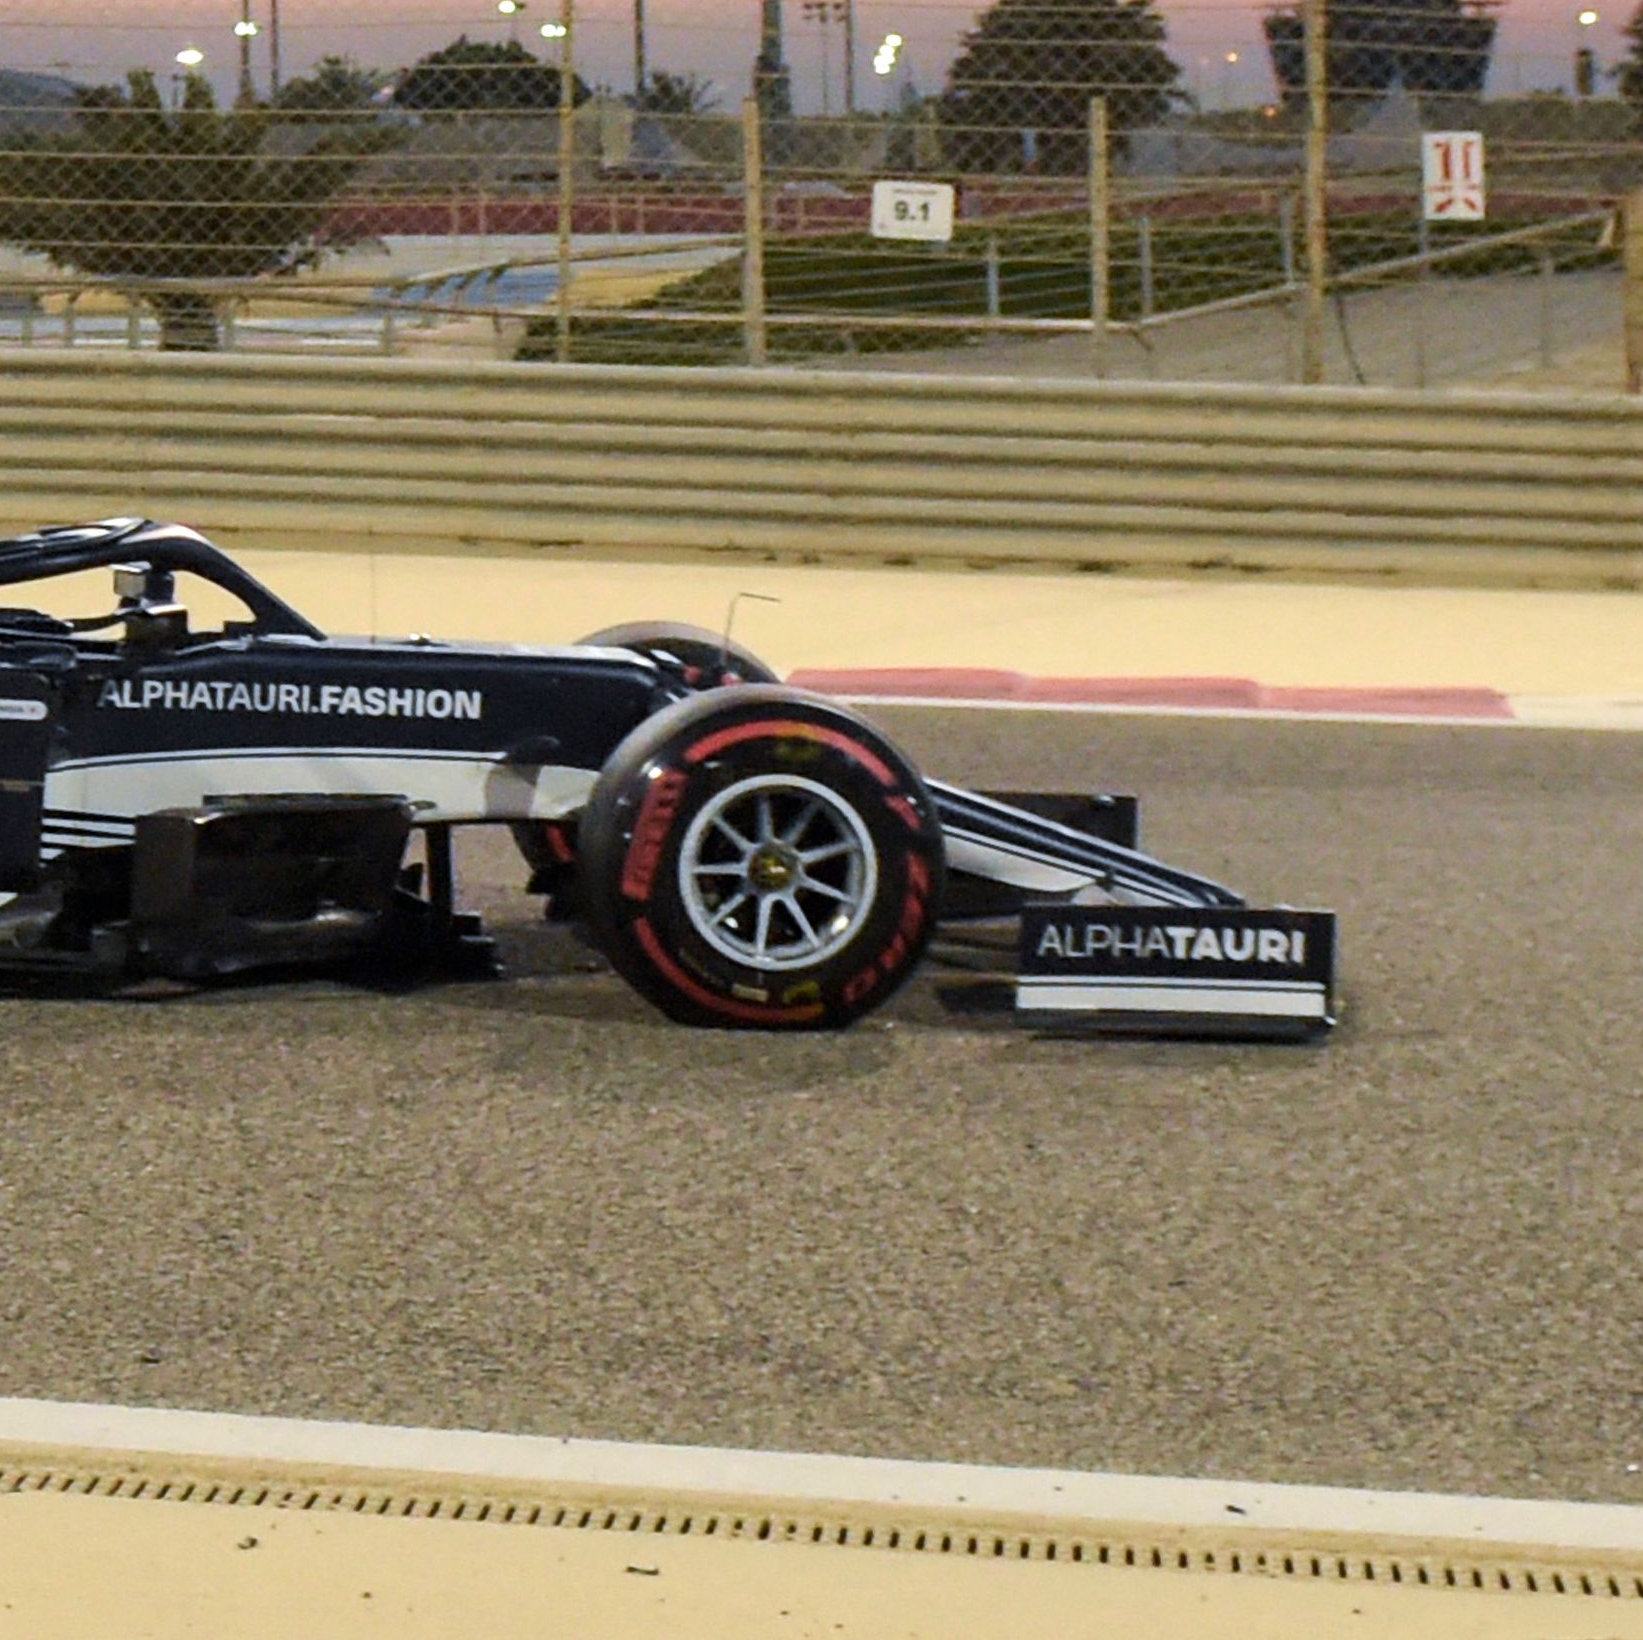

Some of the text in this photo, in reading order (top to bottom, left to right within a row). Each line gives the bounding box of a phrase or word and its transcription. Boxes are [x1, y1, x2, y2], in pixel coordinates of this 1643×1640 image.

[894, 200, 929, 222] 9.1
[97, 679, 482, 720] ALPHATAURI.FASHION
[1038, 924, 1307, 964] ALPHATAURI
